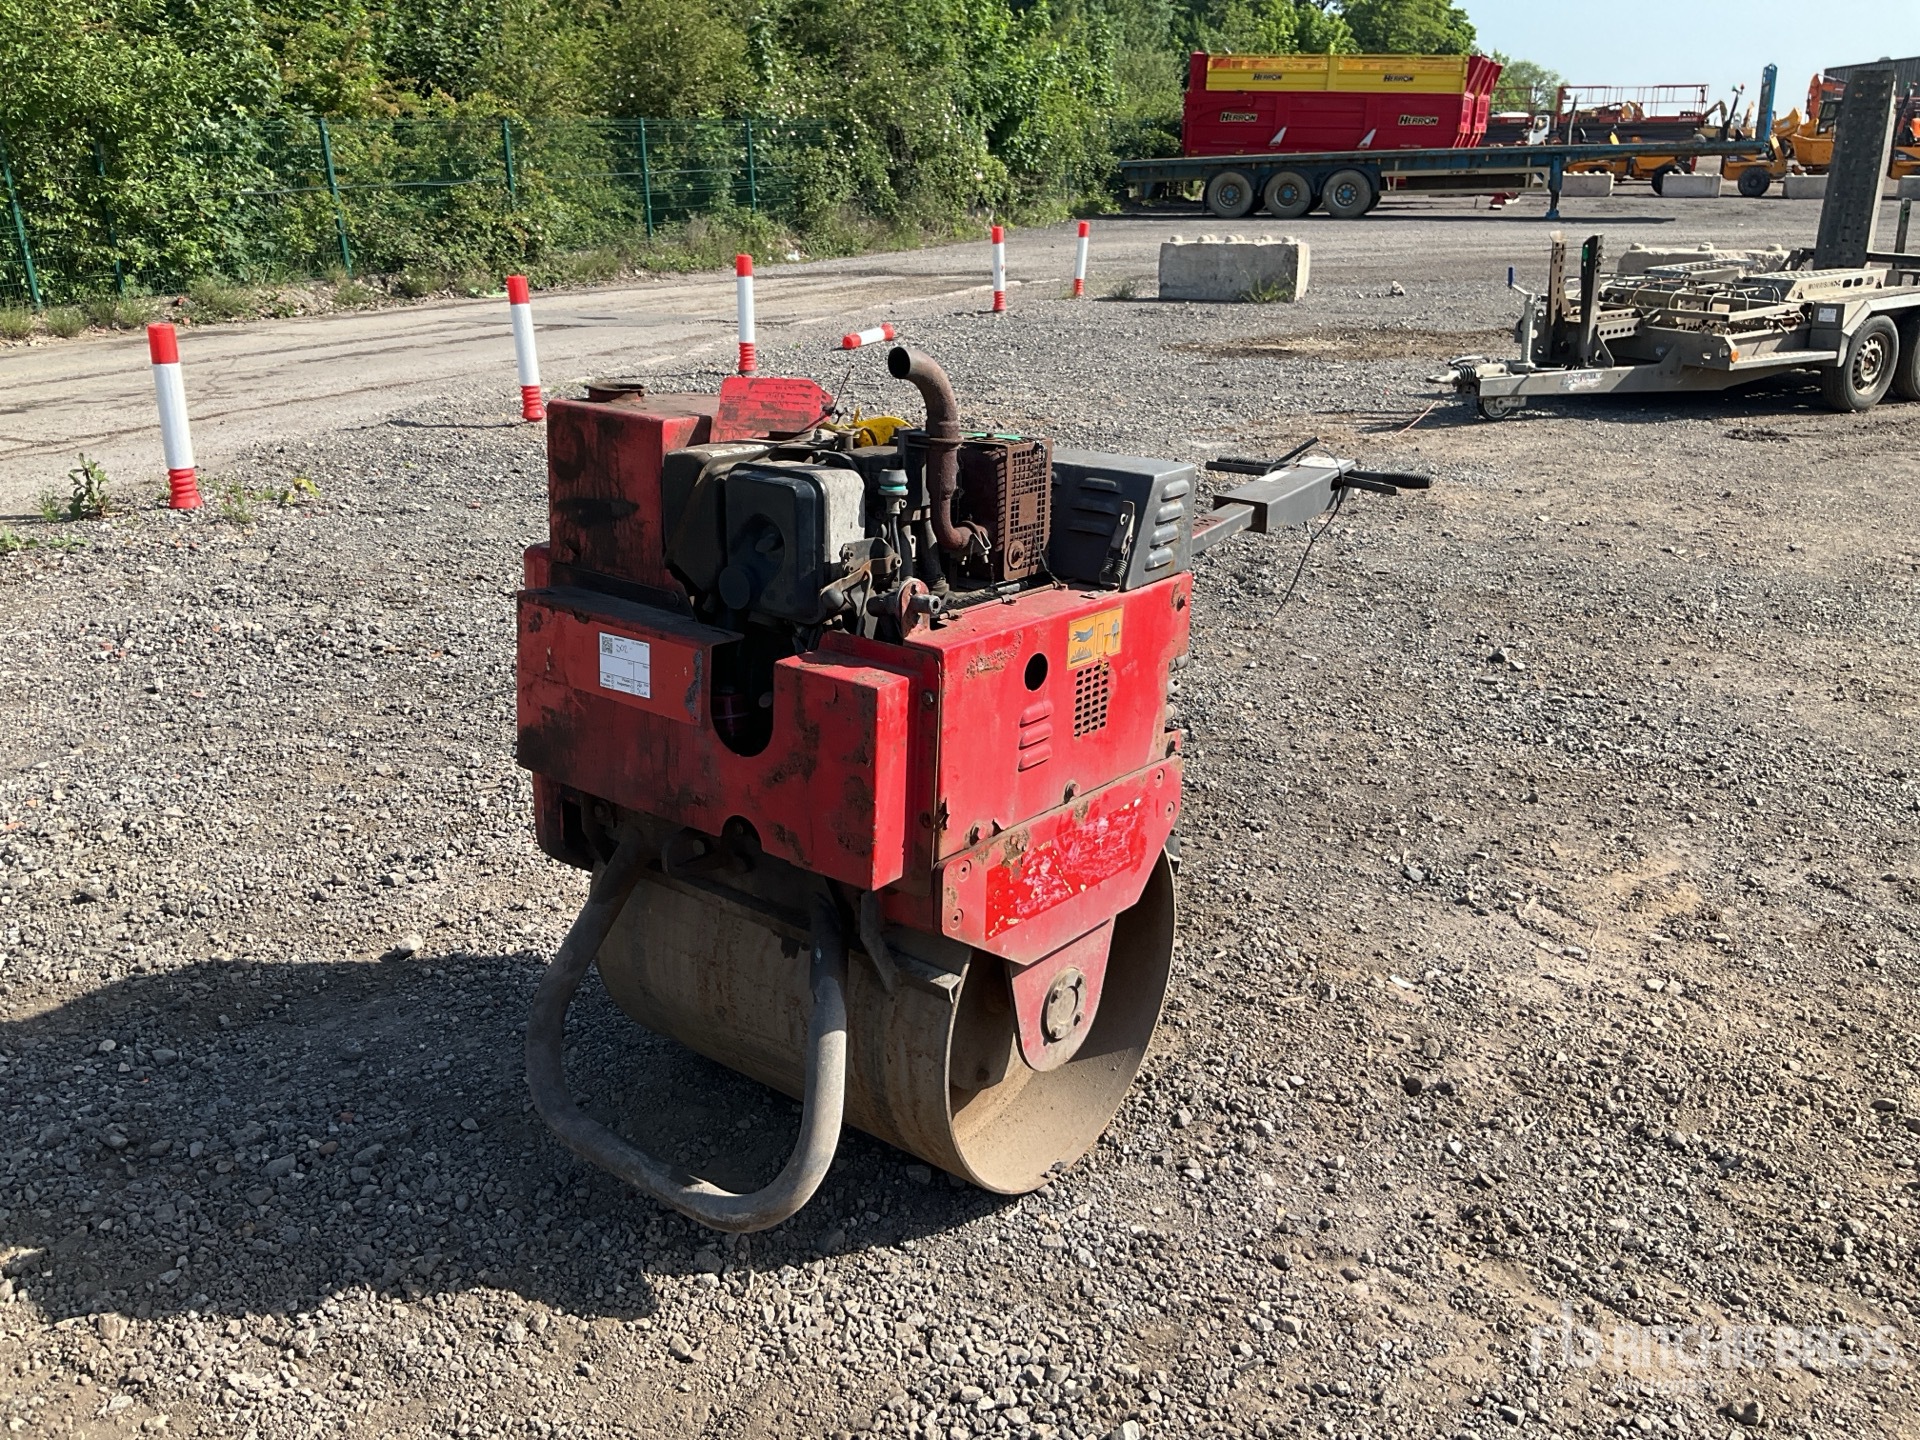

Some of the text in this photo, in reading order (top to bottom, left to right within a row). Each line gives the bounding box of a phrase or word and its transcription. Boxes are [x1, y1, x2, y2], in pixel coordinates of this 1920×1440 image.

[1383, 74, 1413, 82] HERRON
[1221, 113, 1256, 121] HERRON
[1400, 115, 1437, 125] HERRON
